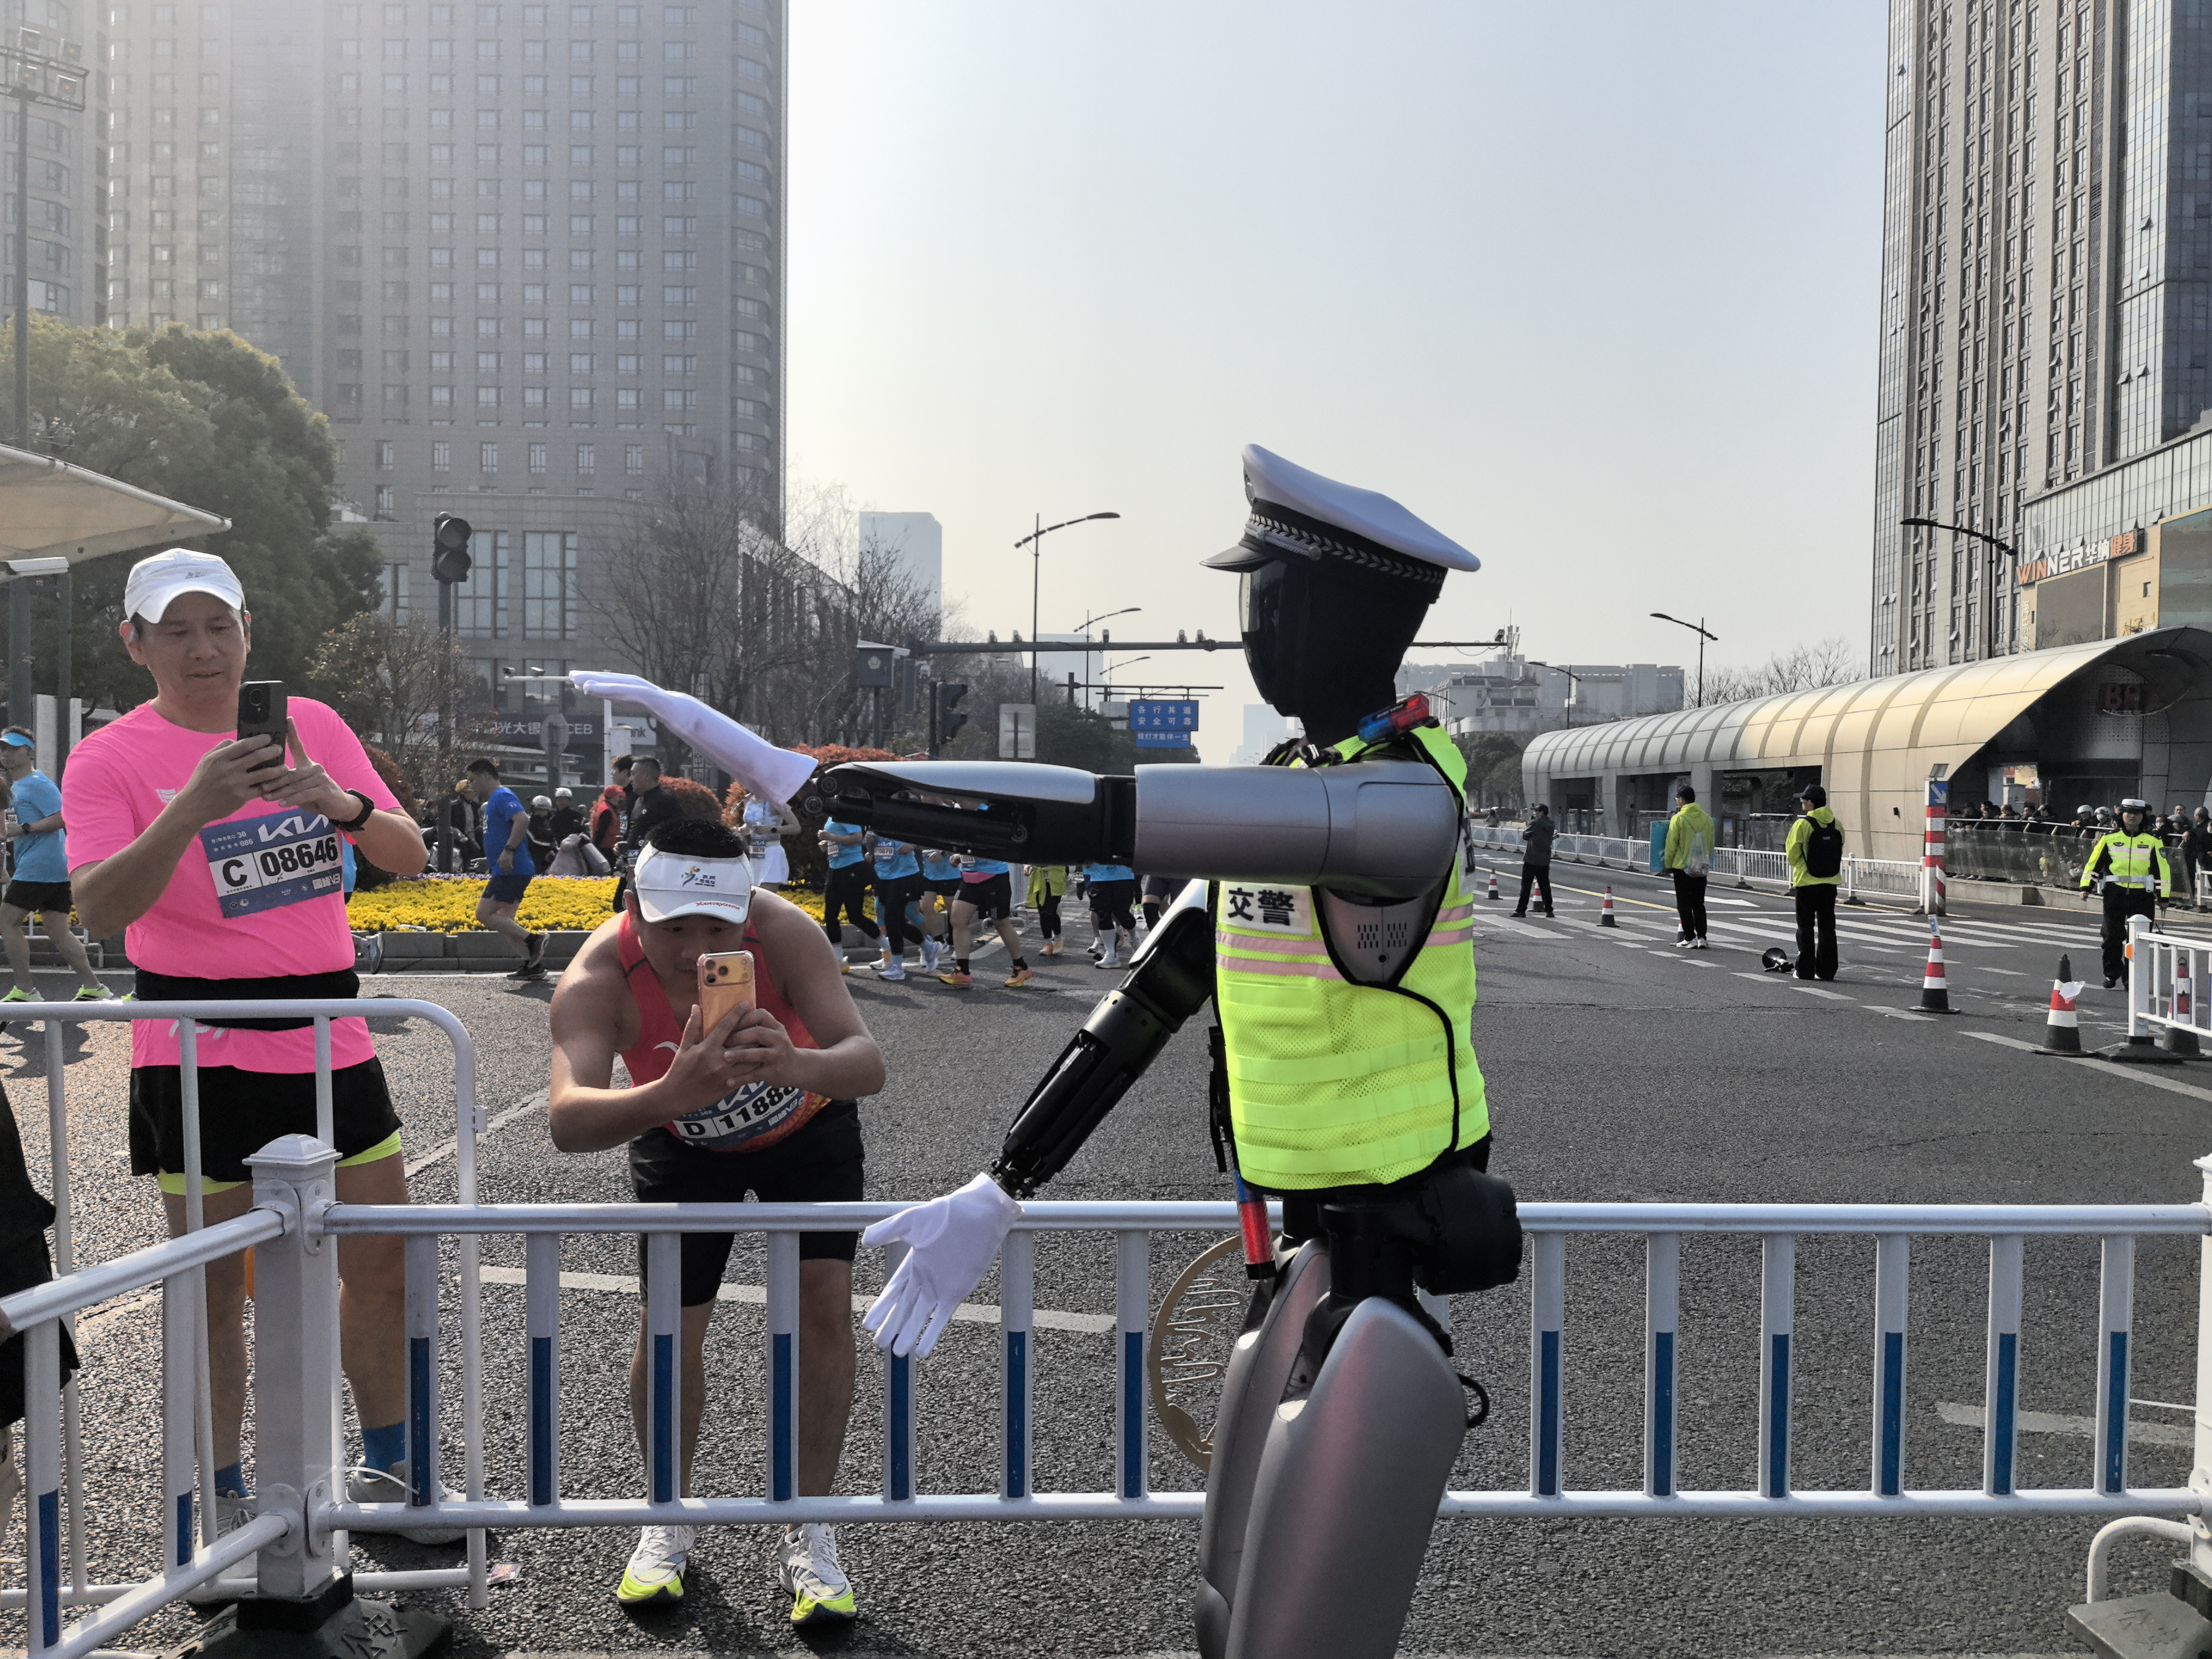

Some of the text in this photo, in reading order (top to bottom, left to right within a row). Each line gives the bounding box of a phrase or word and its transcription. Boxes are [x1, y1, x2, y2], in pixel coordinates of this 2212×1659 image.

[2016, 531, 2136, 585] WINNER 华纳健身
[1138, 705, 1191, 714] 各行其道
[1138, 717, 1192, 725] 安全可靠
[258, 813, 329, 843] KIA
[222, 837, 338, 887] C 08646
[1227, 887, 1294, 926] 交警
[717, 1080, 765, 1111] KI
[683, 1122, 706, 1136] D
